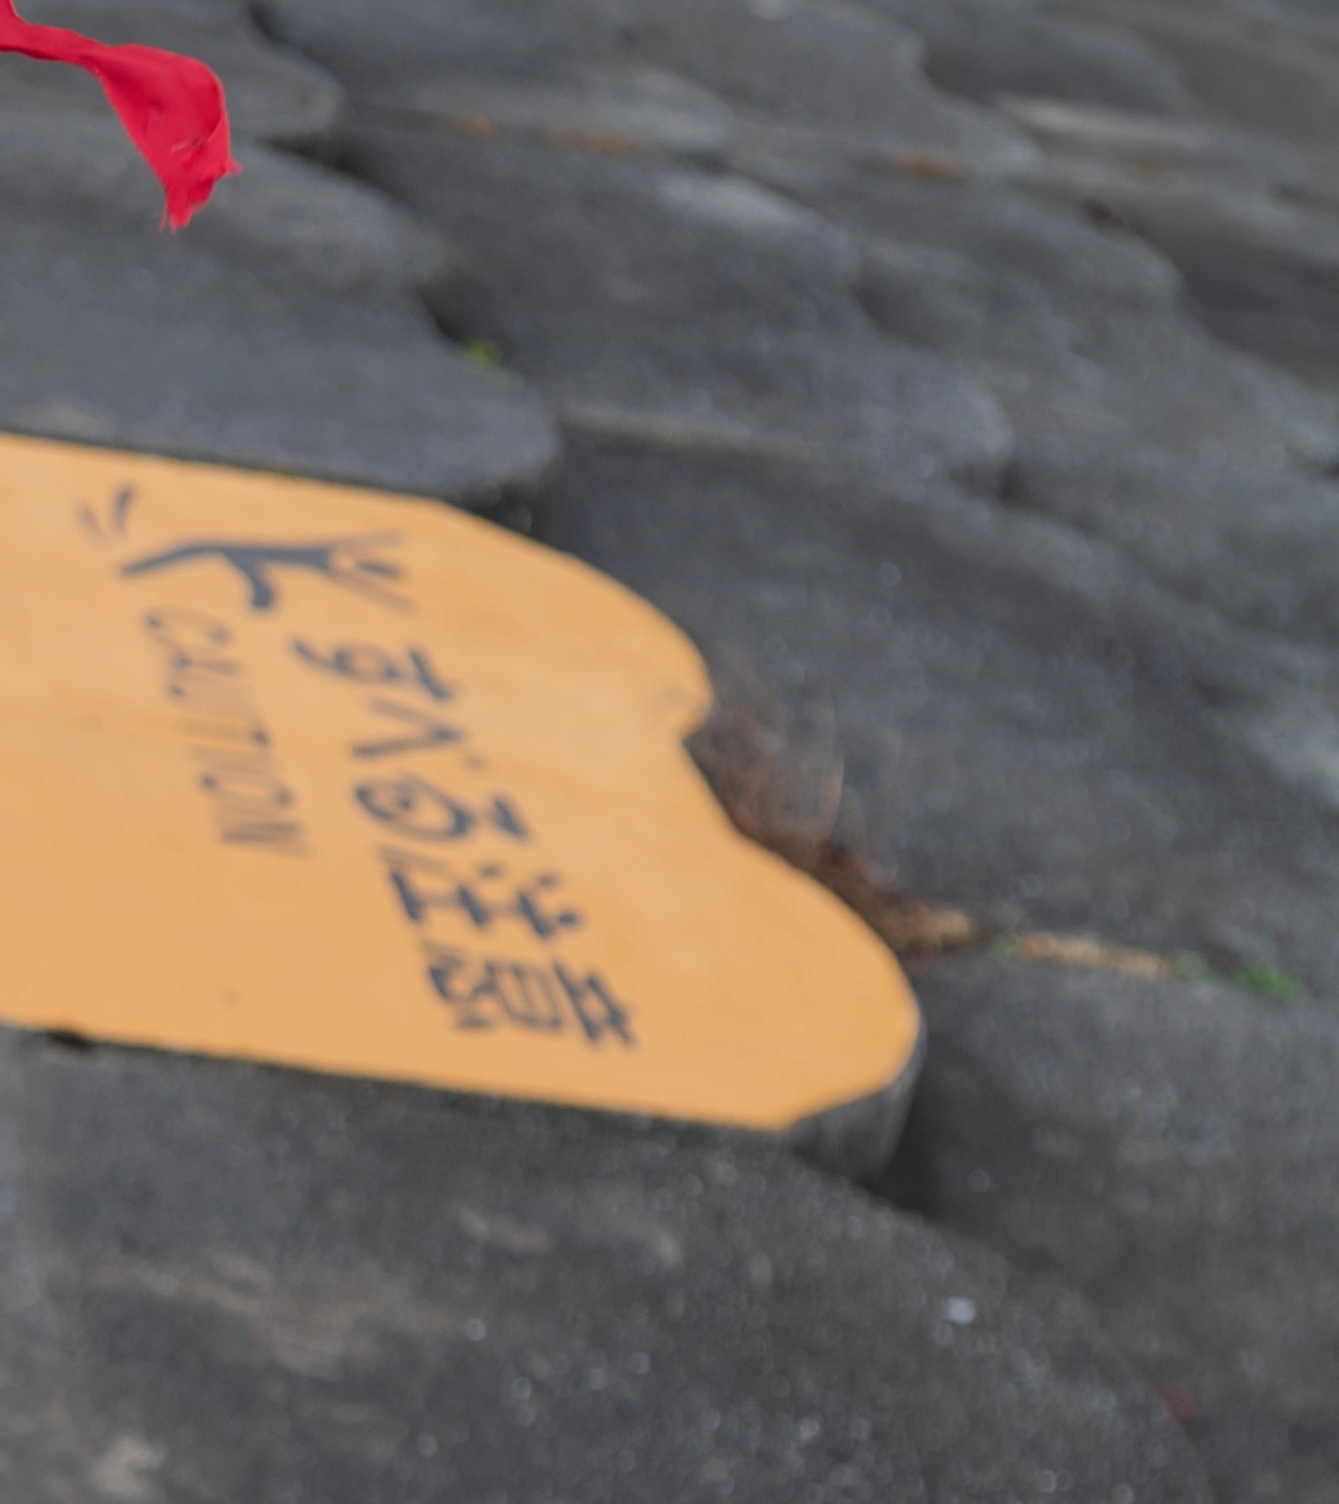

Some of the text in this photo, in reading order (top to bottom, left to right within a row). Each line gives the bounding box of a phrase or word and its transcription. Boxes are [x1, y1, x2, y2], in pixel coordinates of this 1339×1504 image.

[141, 606, 311, 860] CAUTION
[291, 638, 635, 1050] すべる注意
